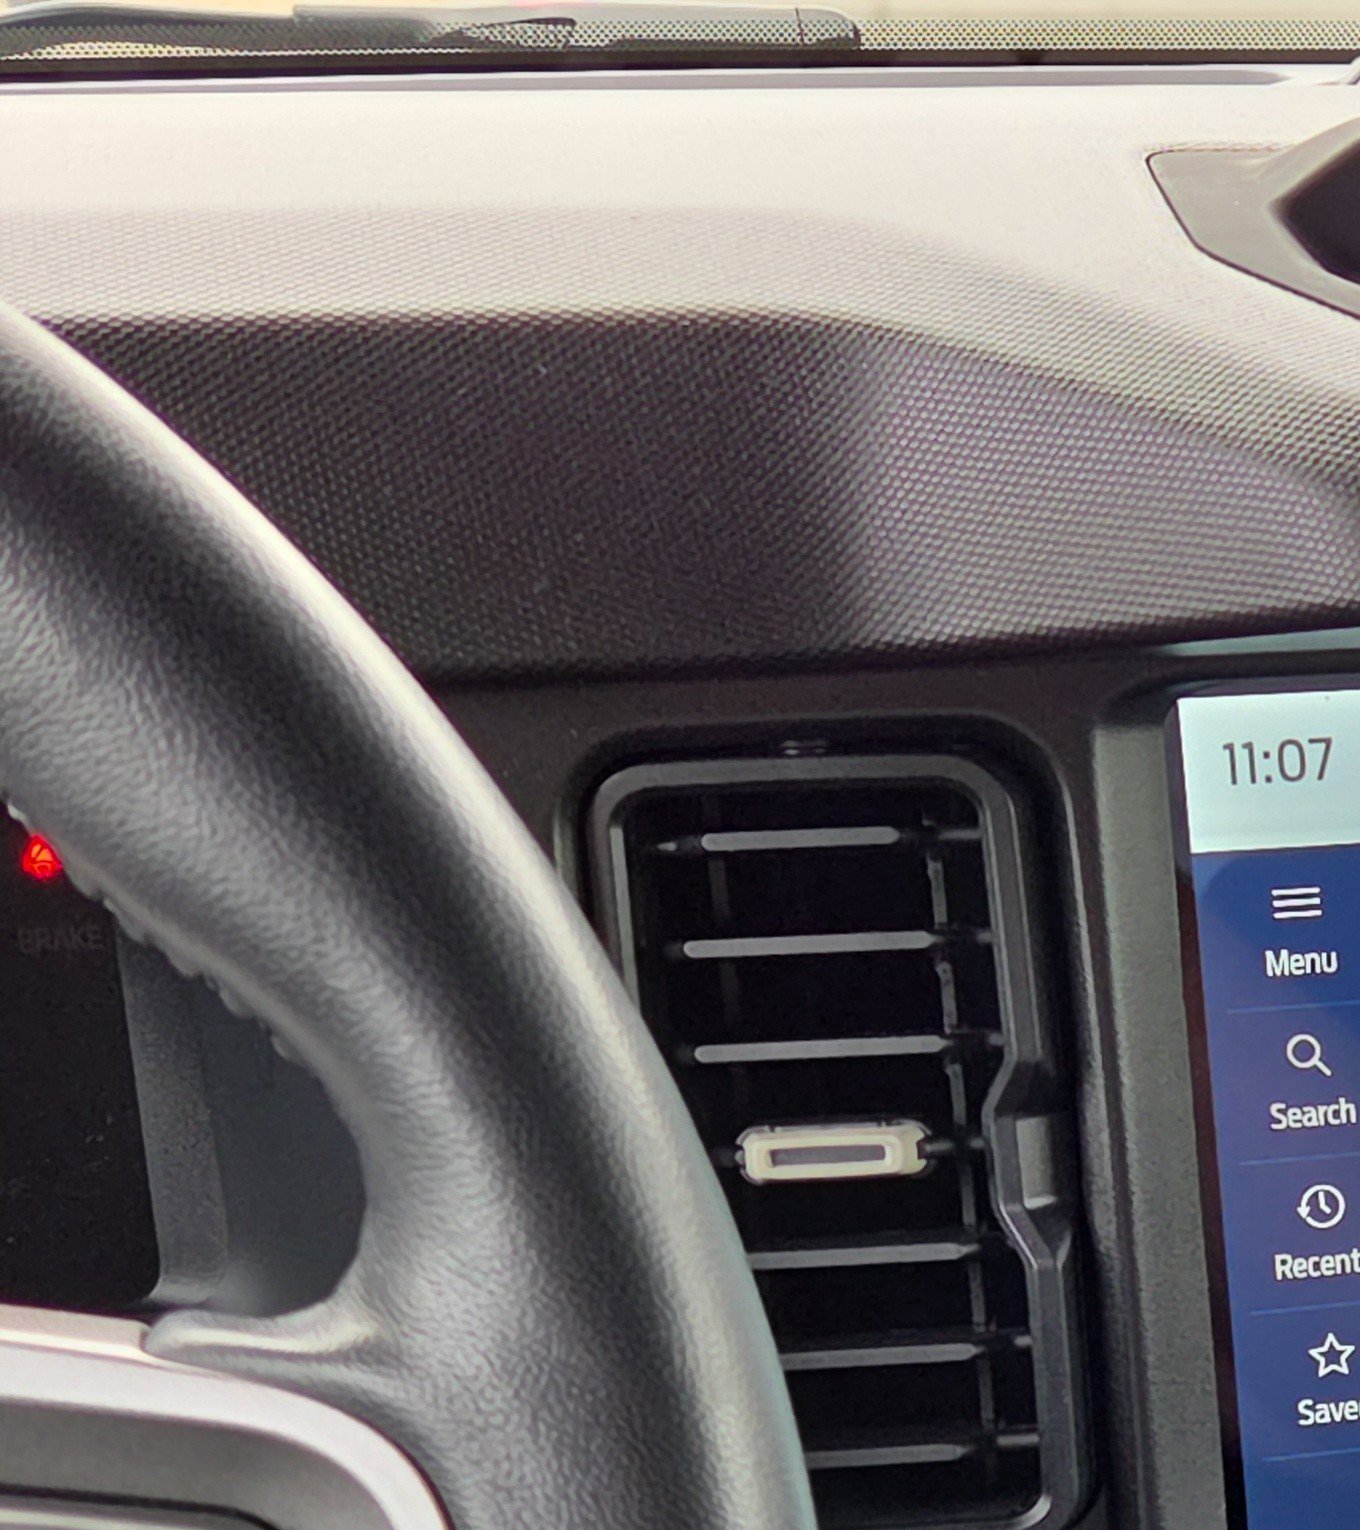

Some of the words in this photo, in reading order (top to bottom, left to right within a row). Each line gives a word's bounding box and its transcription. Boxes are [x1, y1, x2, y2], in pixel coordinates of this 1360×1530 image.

[1222, 737, 1333, 786] 11:07
[1264, 948, 1338, 977] Menu
[1269, 1097, 1357, 1130] Search
